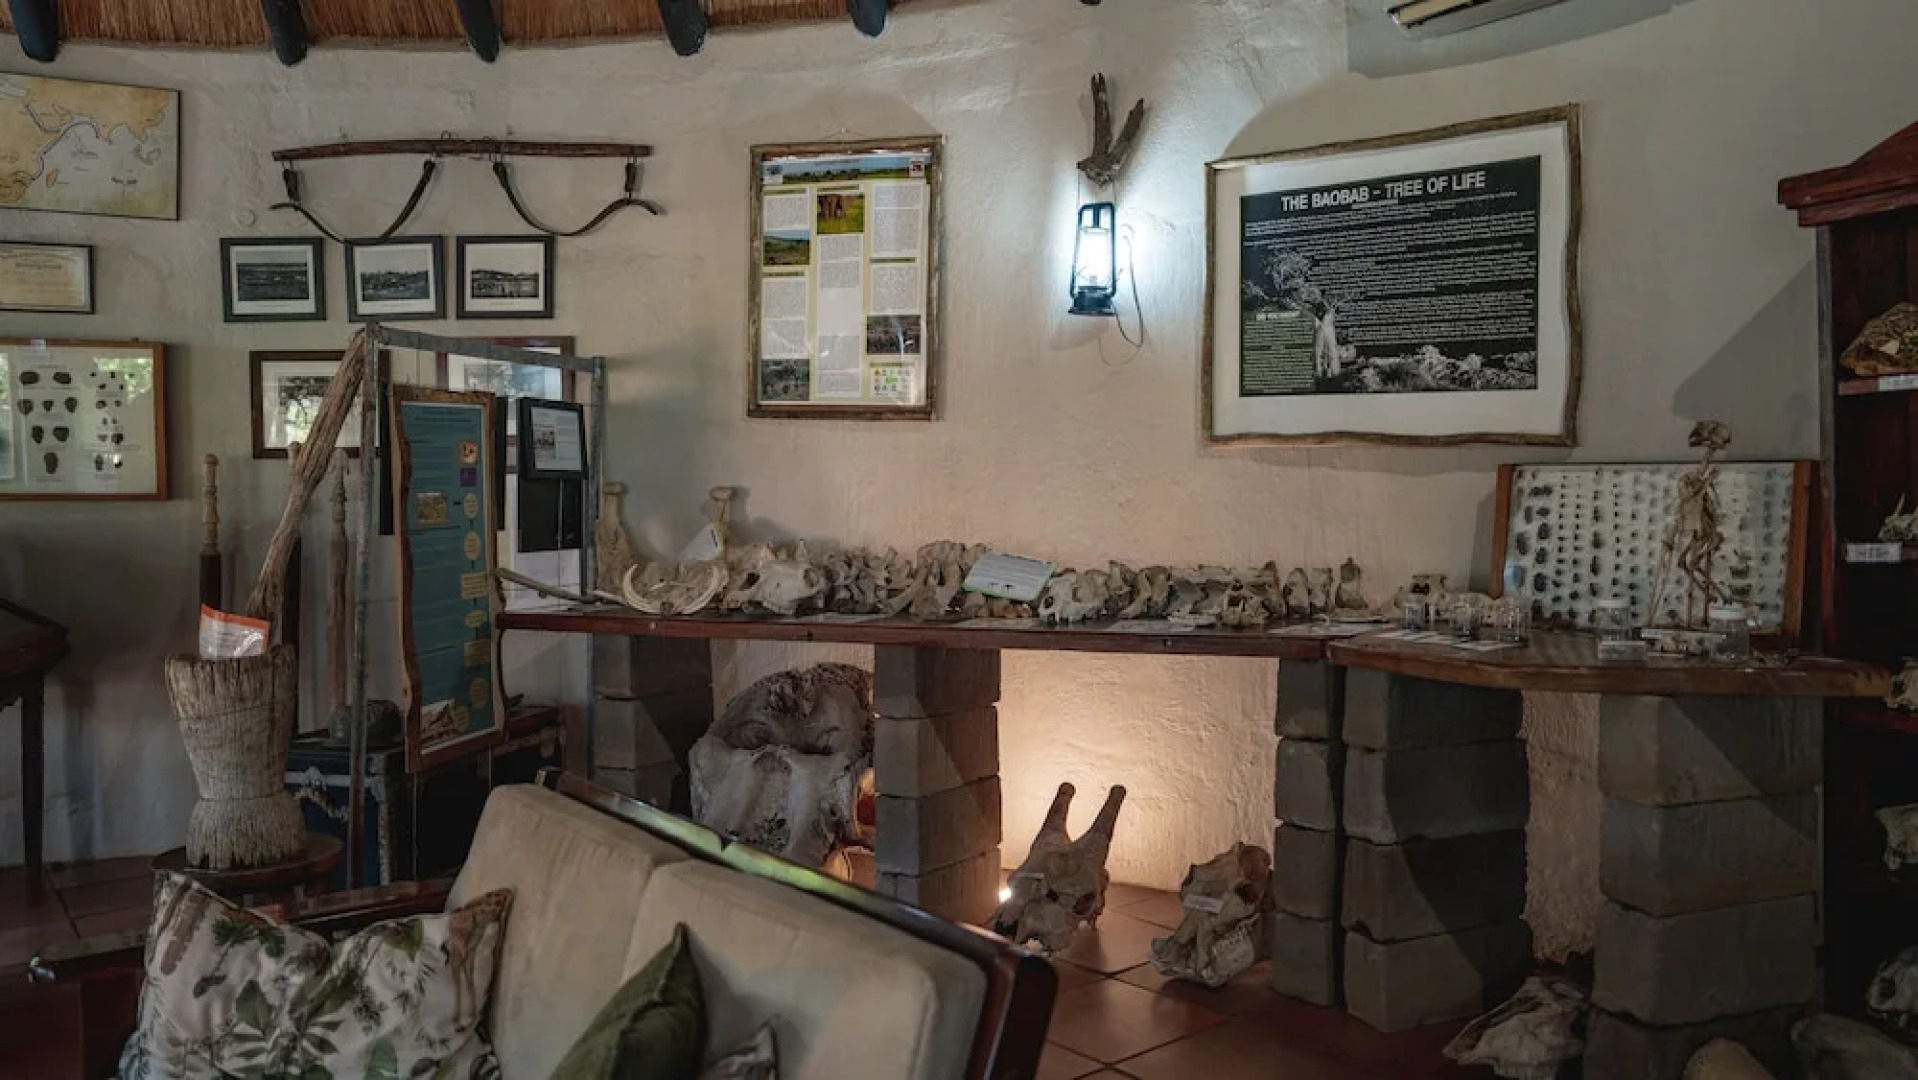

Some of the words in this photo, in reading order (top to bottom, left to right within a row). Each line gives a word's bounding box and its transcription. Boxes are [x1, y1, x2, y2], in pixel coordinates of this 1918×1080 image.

[1281, 194, 1308, 211] THE
[1312, 186, 1369, 208] BAOBAB
[1385, 179, 1422, 198] TREE
[1427, 176, 1448, 194] OF
[1453, 171, 1485, 190] LIFE
